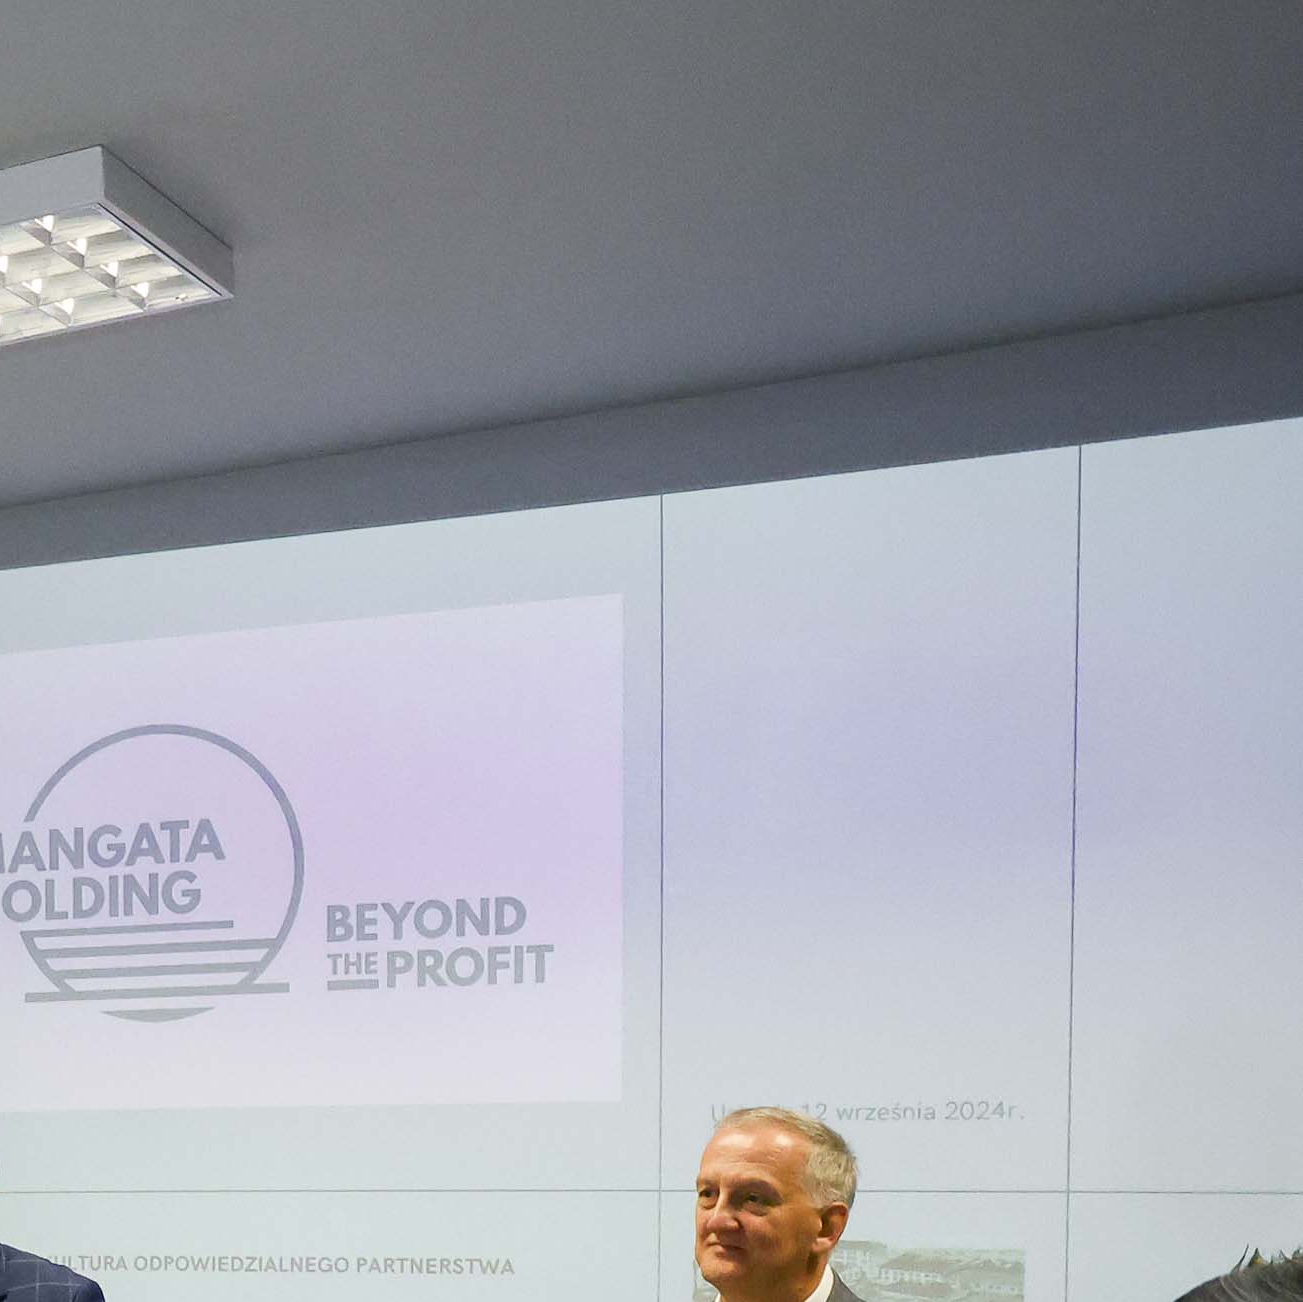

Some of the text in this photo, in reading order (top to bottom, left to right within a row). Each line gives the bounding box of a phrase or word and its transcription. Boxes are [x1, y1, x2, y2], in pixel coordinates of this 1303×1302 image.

[326, 896, 527, 942] BEYOND
[327, 944, 555, 988] THE PROFIT
[835, 1099, 937, 1121] września
[944, 1100, 1025, 1121] 2024r.
[49, 1255, 516, 1275] ULTURA ODPOWIEDZIALNEGO PARTNERSTWA
